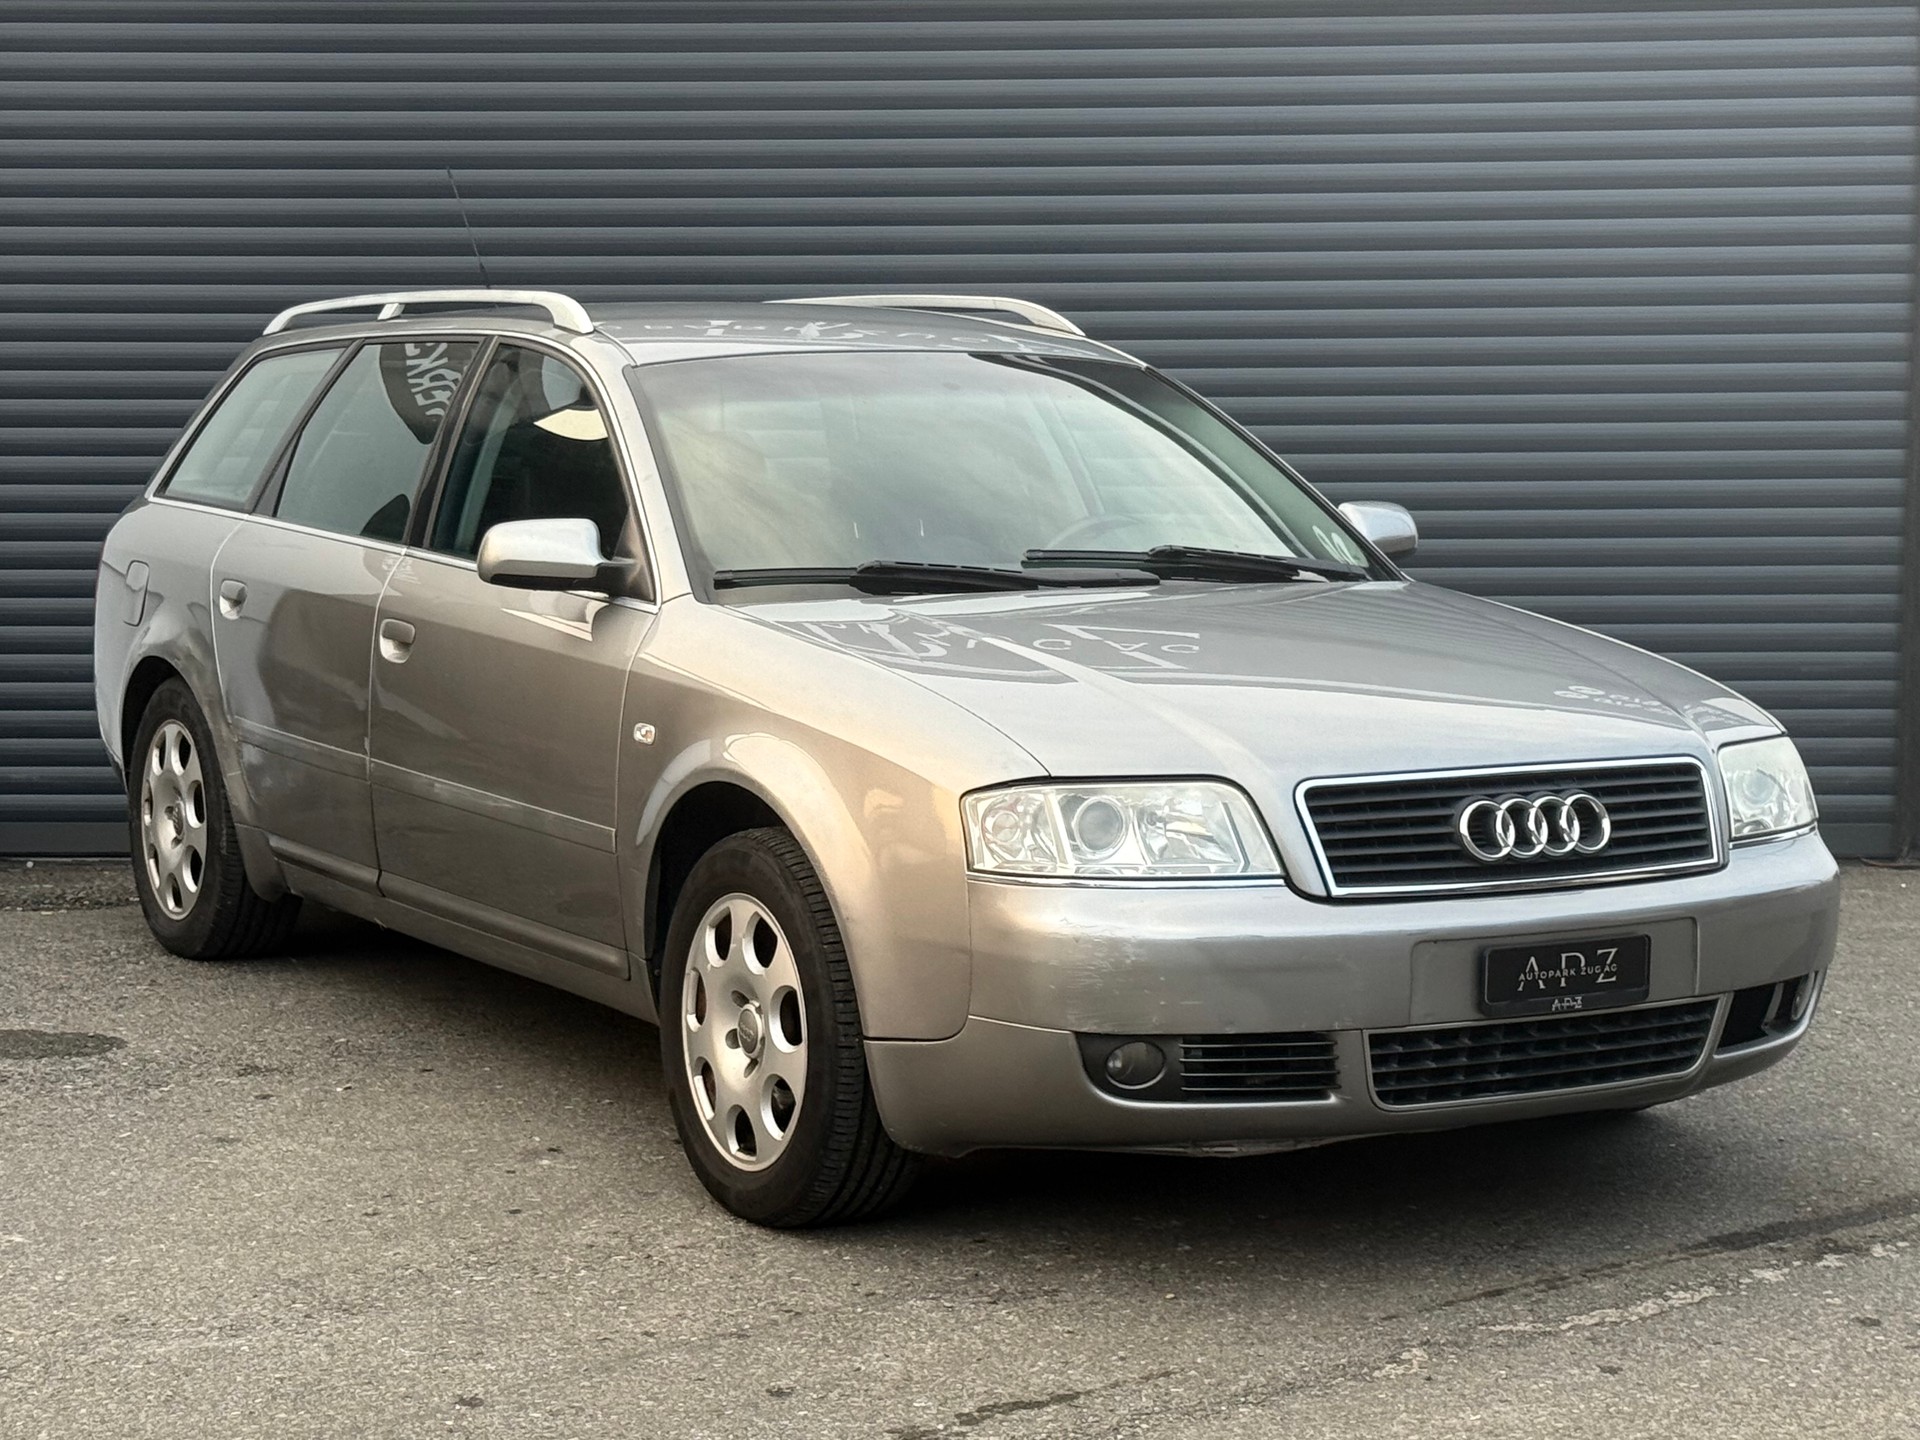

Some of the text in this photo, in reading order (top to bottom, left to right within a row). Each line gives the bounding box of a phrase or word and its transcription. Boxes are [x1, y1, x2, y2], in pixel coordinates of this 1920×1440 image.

[1517, 947, 1619, 991] APZ
[1518, 963, 1618, 981] AUTOPARK ZUG AG
[1551, 996, 1583, 1011] APZ
